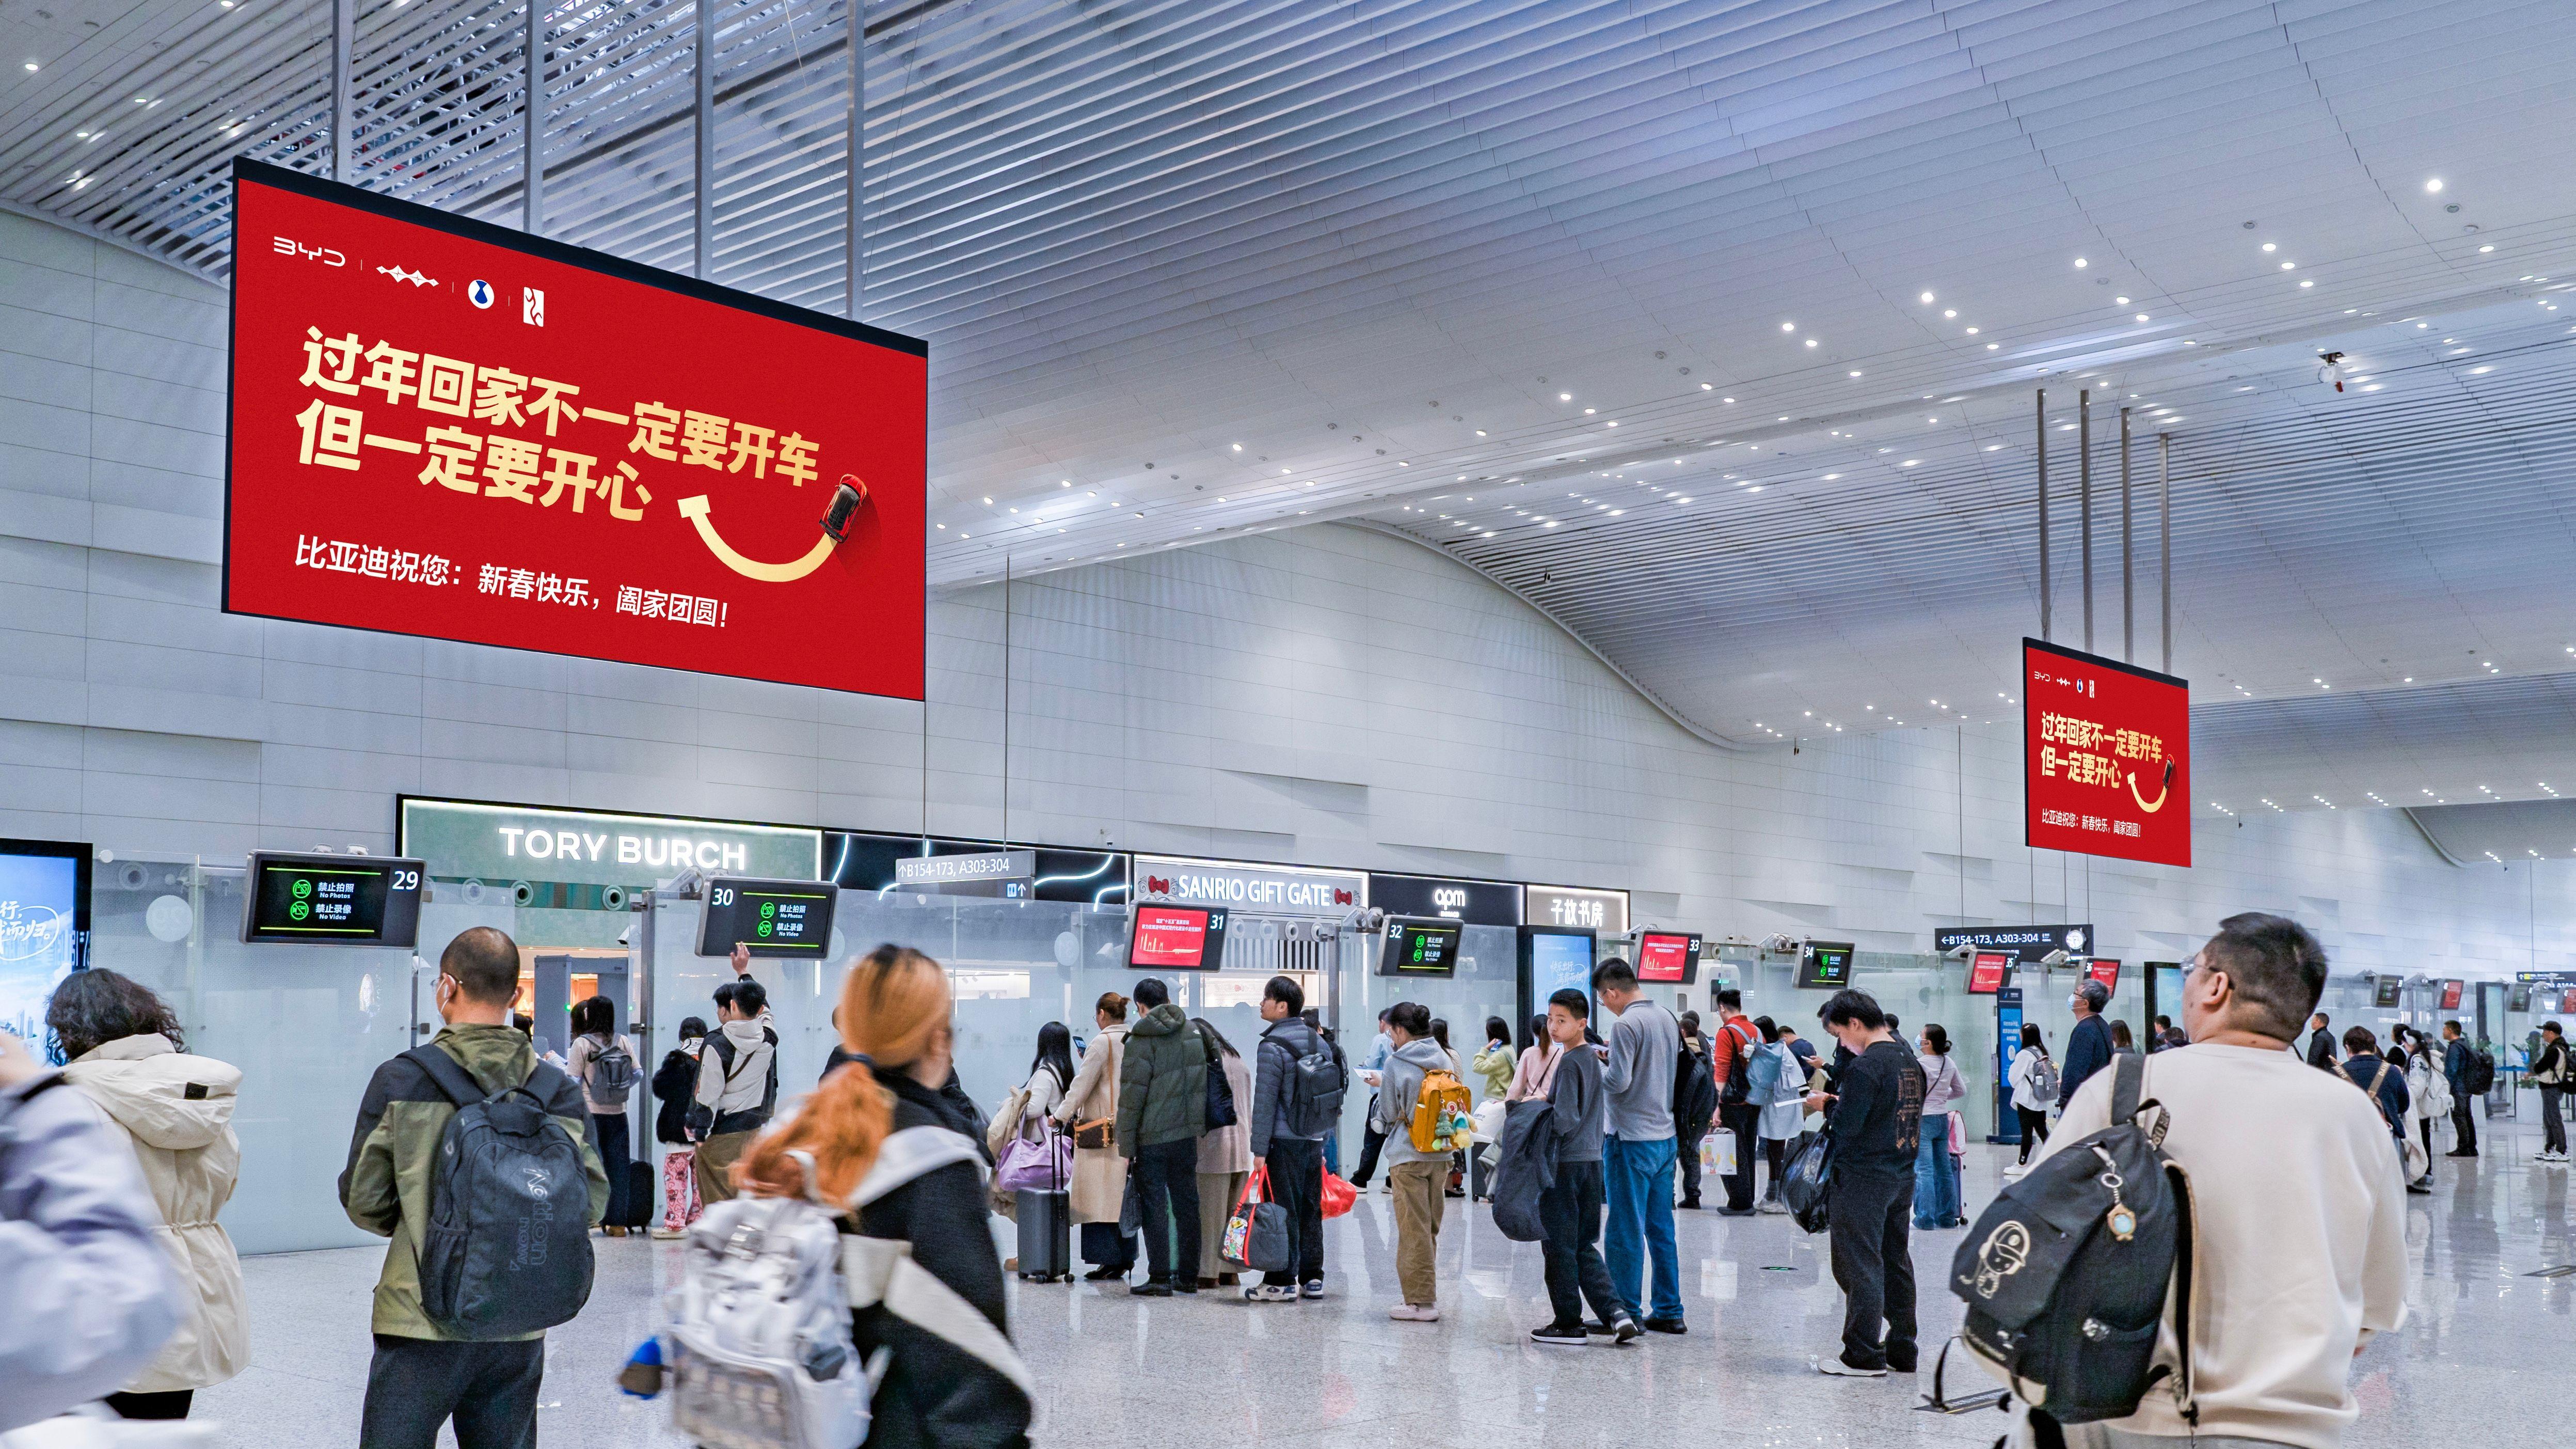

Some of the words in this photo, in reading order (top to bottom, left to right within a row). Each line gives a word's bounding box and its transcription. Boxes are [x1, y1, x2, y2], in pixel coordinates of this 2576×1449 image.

[274, 235, 346, 267] BYD
[298, 325, 821, 487] 过年回家不一定要开车
[296, 399, 653, 523] 但一定要开心
[2034, 671, 2050, 682] BYD
[2041, 711, 2162, 763] 过年回家不一定要开车
[2041, 745, 2121, 789] 但一定要开心
[498, 827, 609, 861] TORY
[617, 836, 745, 871] BURCH
[907, 859, 957, 877] B154-173,
[959, 858, 1010, 874] A303-304
[318, 882, 355, 893] 禁止拍照
[392, 871, 419, 890] 29
[712, 888, 734, 906] 30
[1178, 874, 1244, 902] SANRIO
[1247, 880, 1284, 905] GIFT
[1286, 883, 1330, 907] GATE
[1434, 889, 1465, 910] apm
[315, 904, 352, 914] 禁止录像
[780, 904, 806, 914] 禁止拍照
[1550, 899, 1603, 927] 子故书房
[776, 923, 803, 932] 禁止录像
[1210, 915, 1224, 930] 31
[1389, 925, 1402, 938] 32
[1689, 940, 1699, 951] 33
[1949, 935, 1993, 945] B154-173,
[1995, 933, 2039, 943] A303-304
[1804, 946, 1814, 958] 34
[2006, 958, 2014, 968] 35
